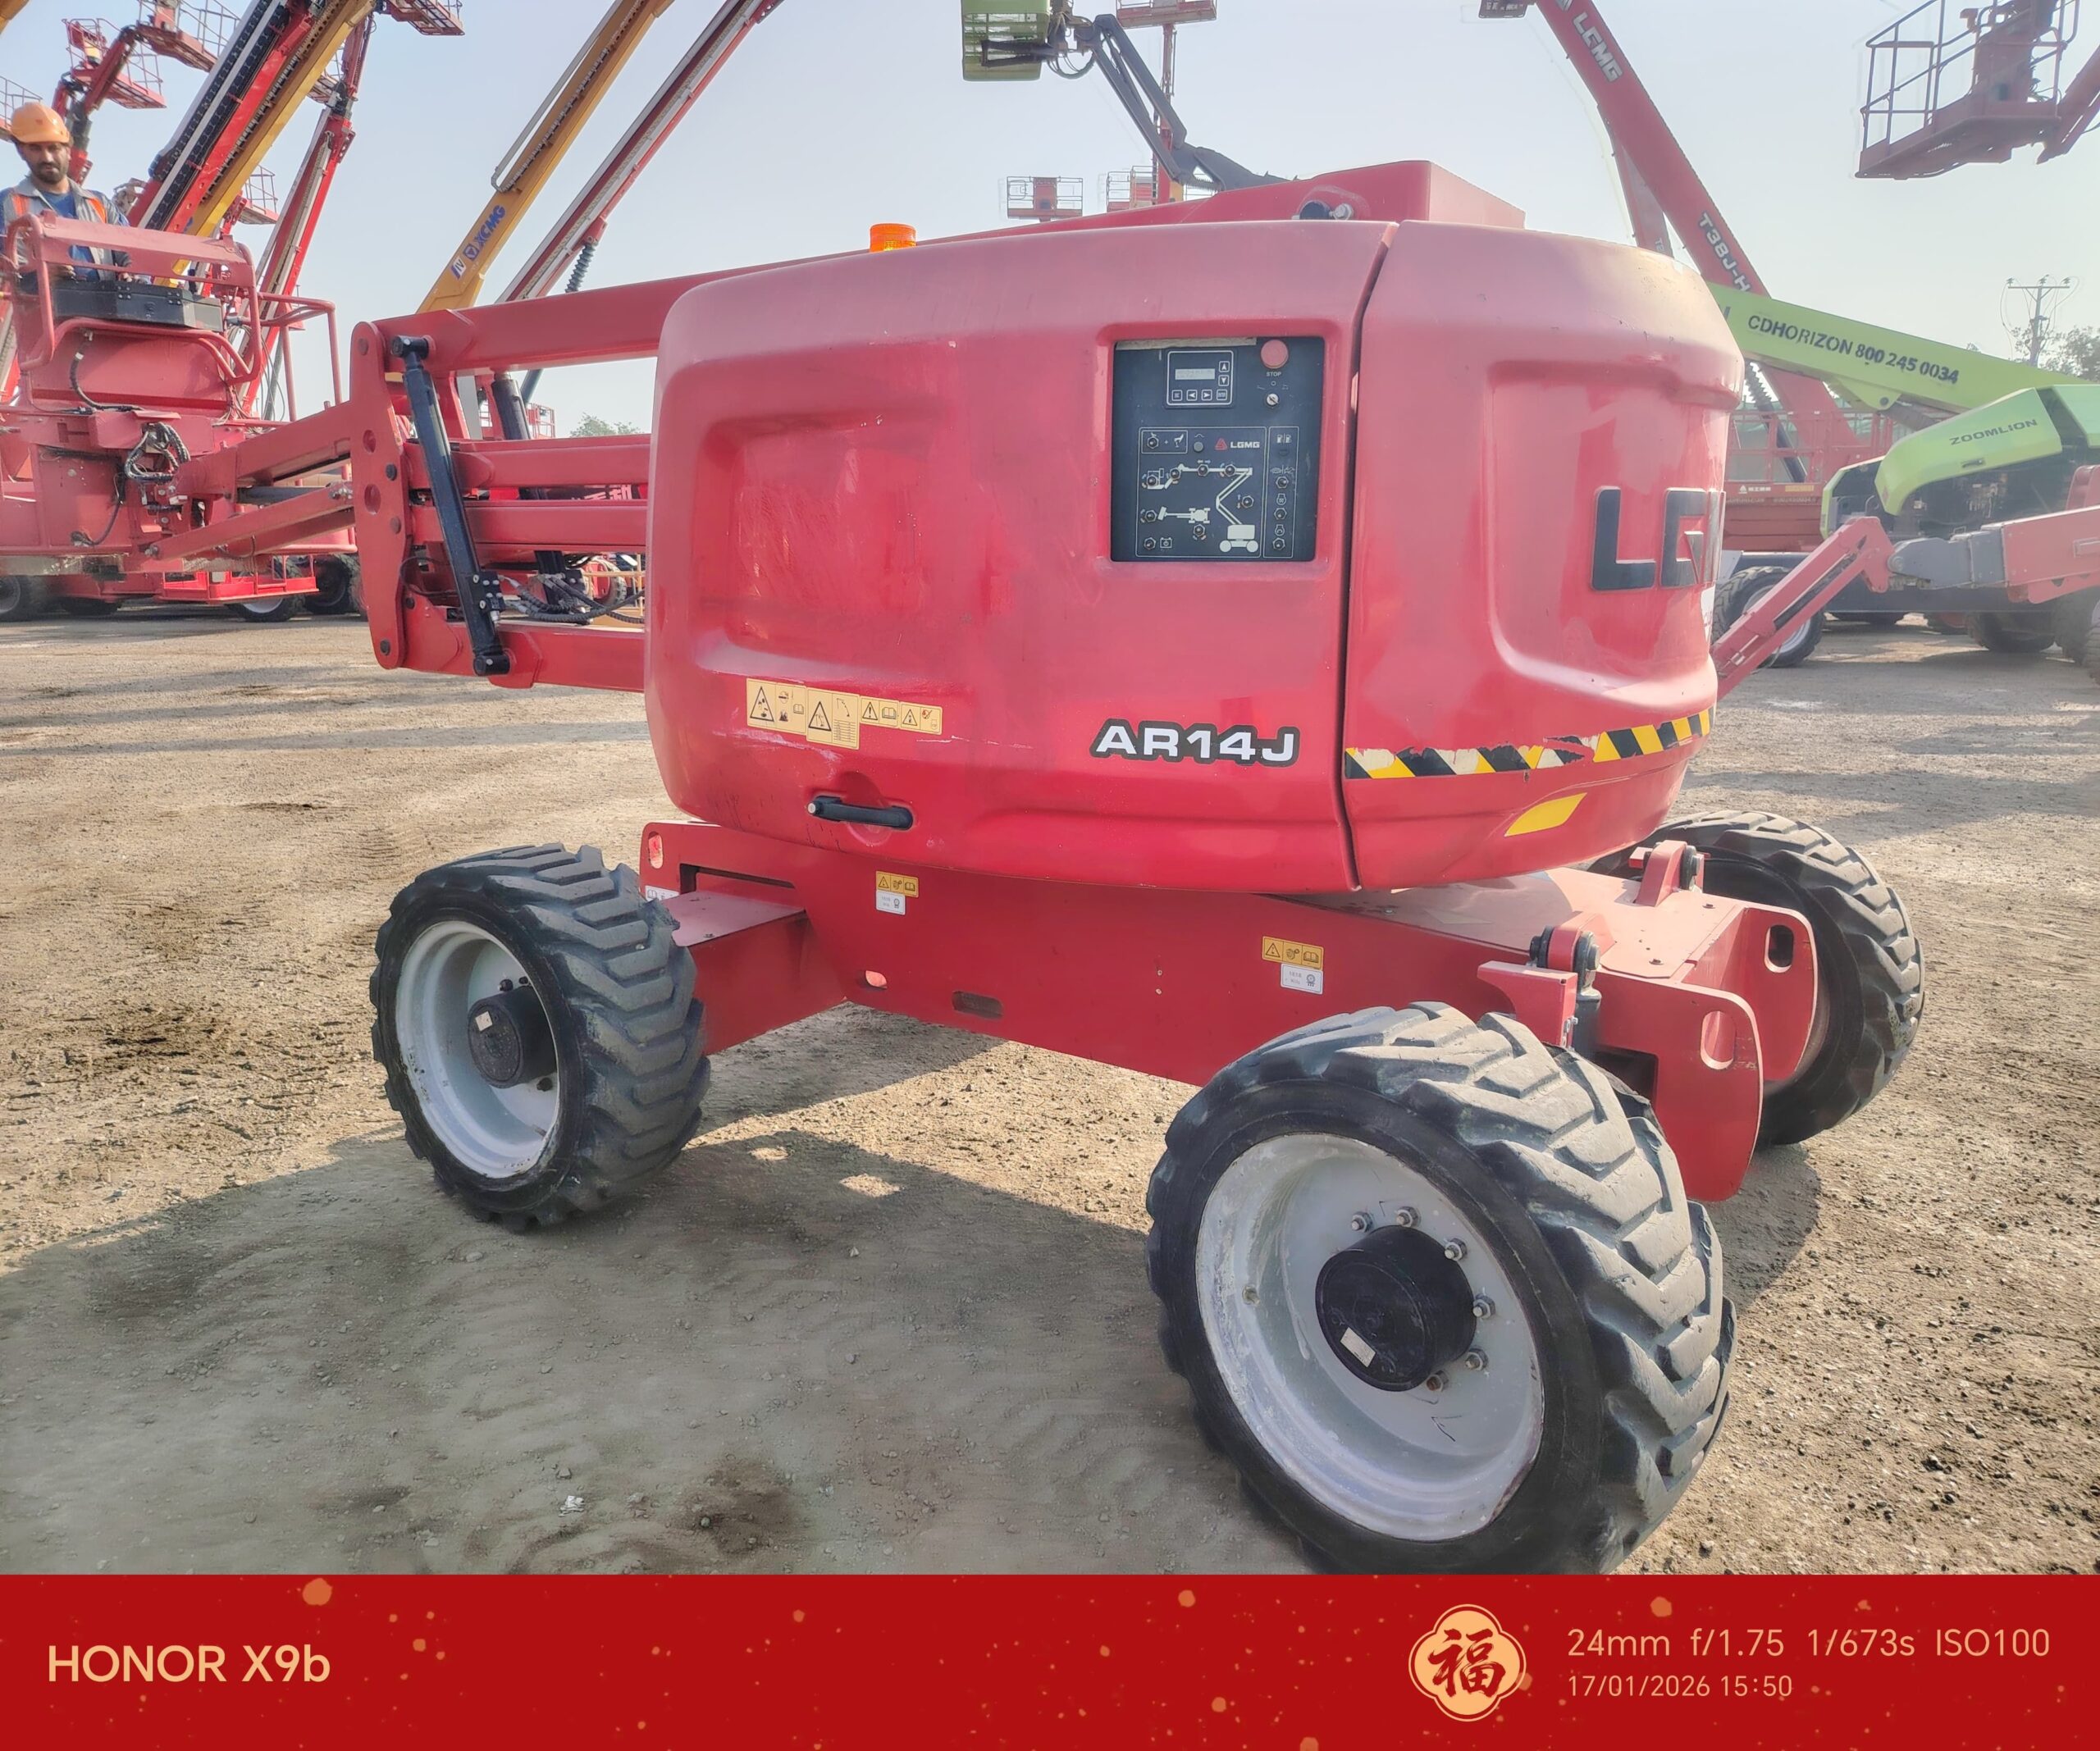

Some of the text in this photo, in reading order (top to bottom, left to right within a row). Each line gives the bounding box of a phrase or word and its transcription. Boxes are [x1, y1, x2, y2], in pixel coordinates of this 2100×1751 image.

[1573, 11, 1623, 83] LGMG
[473, 204, 506, 249] XCMG
[1699, 212, 1751, 292] T38J-H
[1748, 315, 1960, 385] CDHORIZON 800 245 0034
[1949, 418, 2038, 445] ZOOMLION
[1591, 486, 1725, 591] LG
[1093, 722, 1297, 764] AR14J
